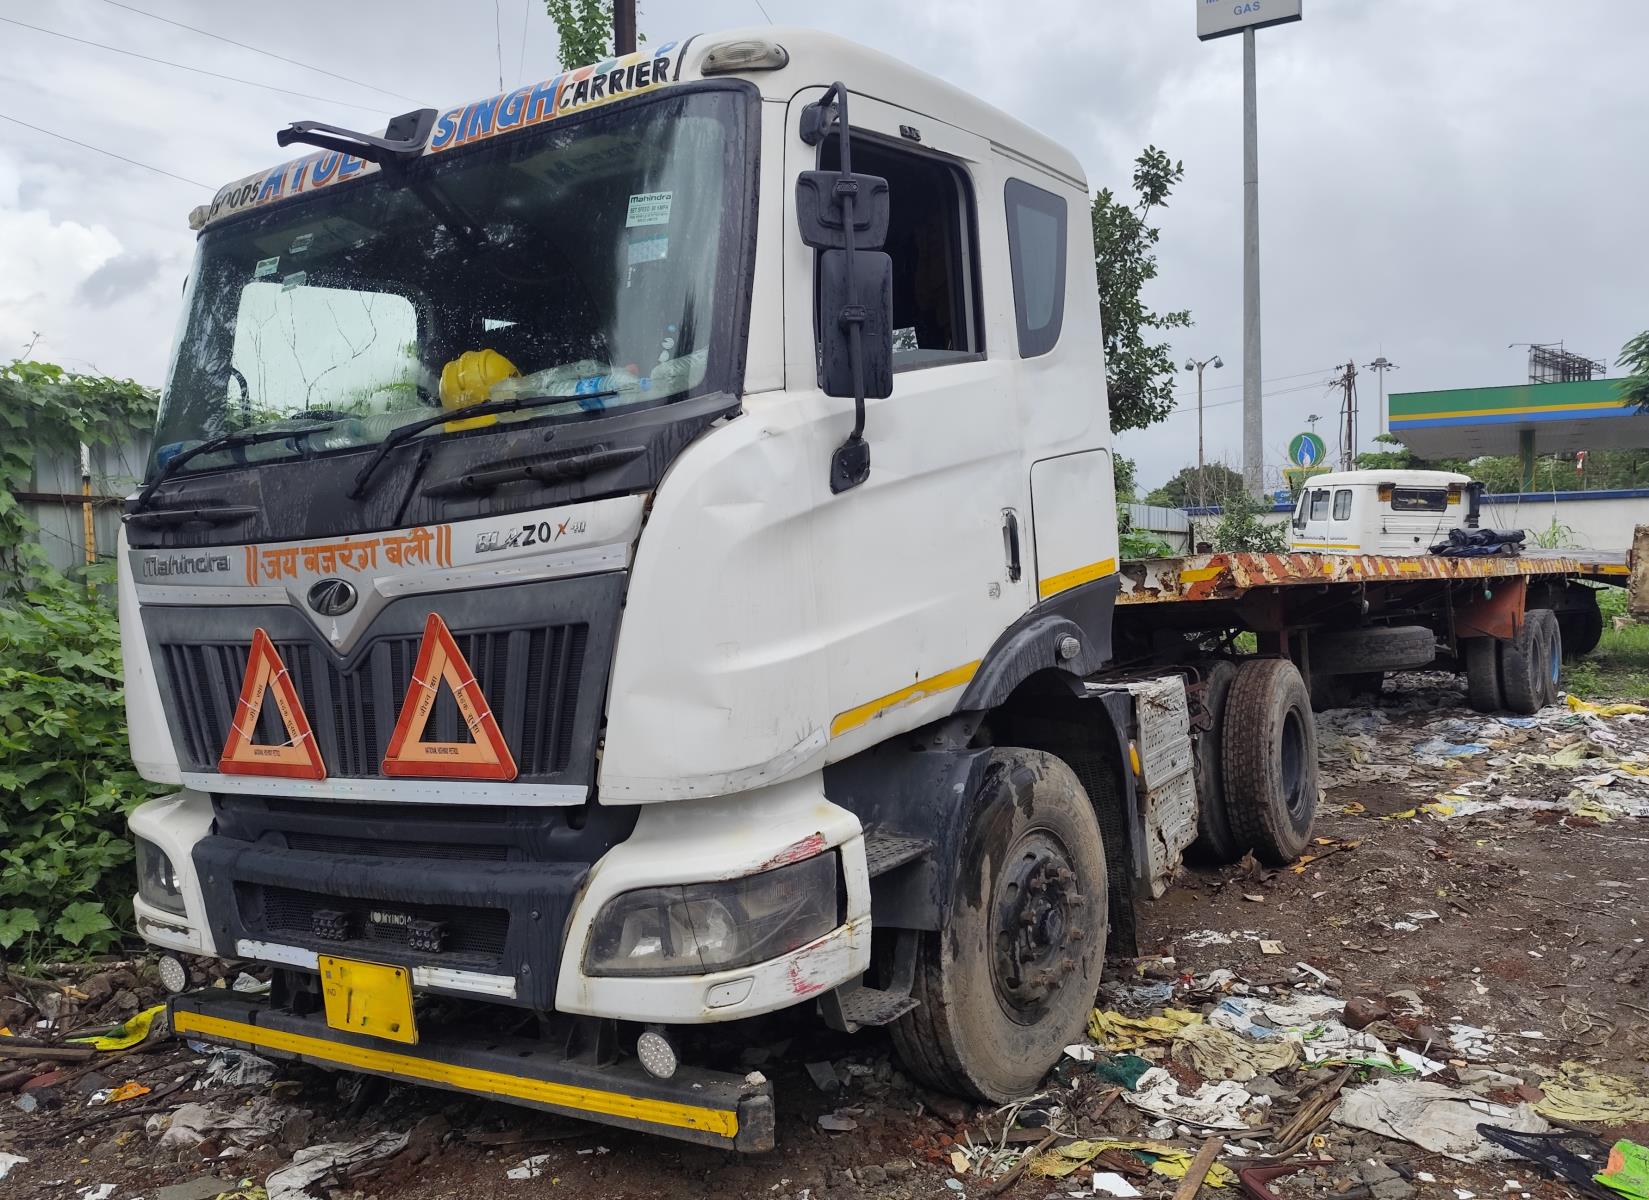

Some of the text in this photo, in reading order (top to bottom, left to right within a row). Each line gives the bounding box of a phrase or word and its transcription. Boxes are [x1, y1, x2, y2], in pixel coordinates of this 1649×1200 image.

[1233, 1, 1261, 16] GAS
[559, 56, 671, 110] CARRIER
[430, 75, 566, 151] SINGH
[630, 193, 672, 204] Mahindra
[143, 552, 231, 578] Mahindra
